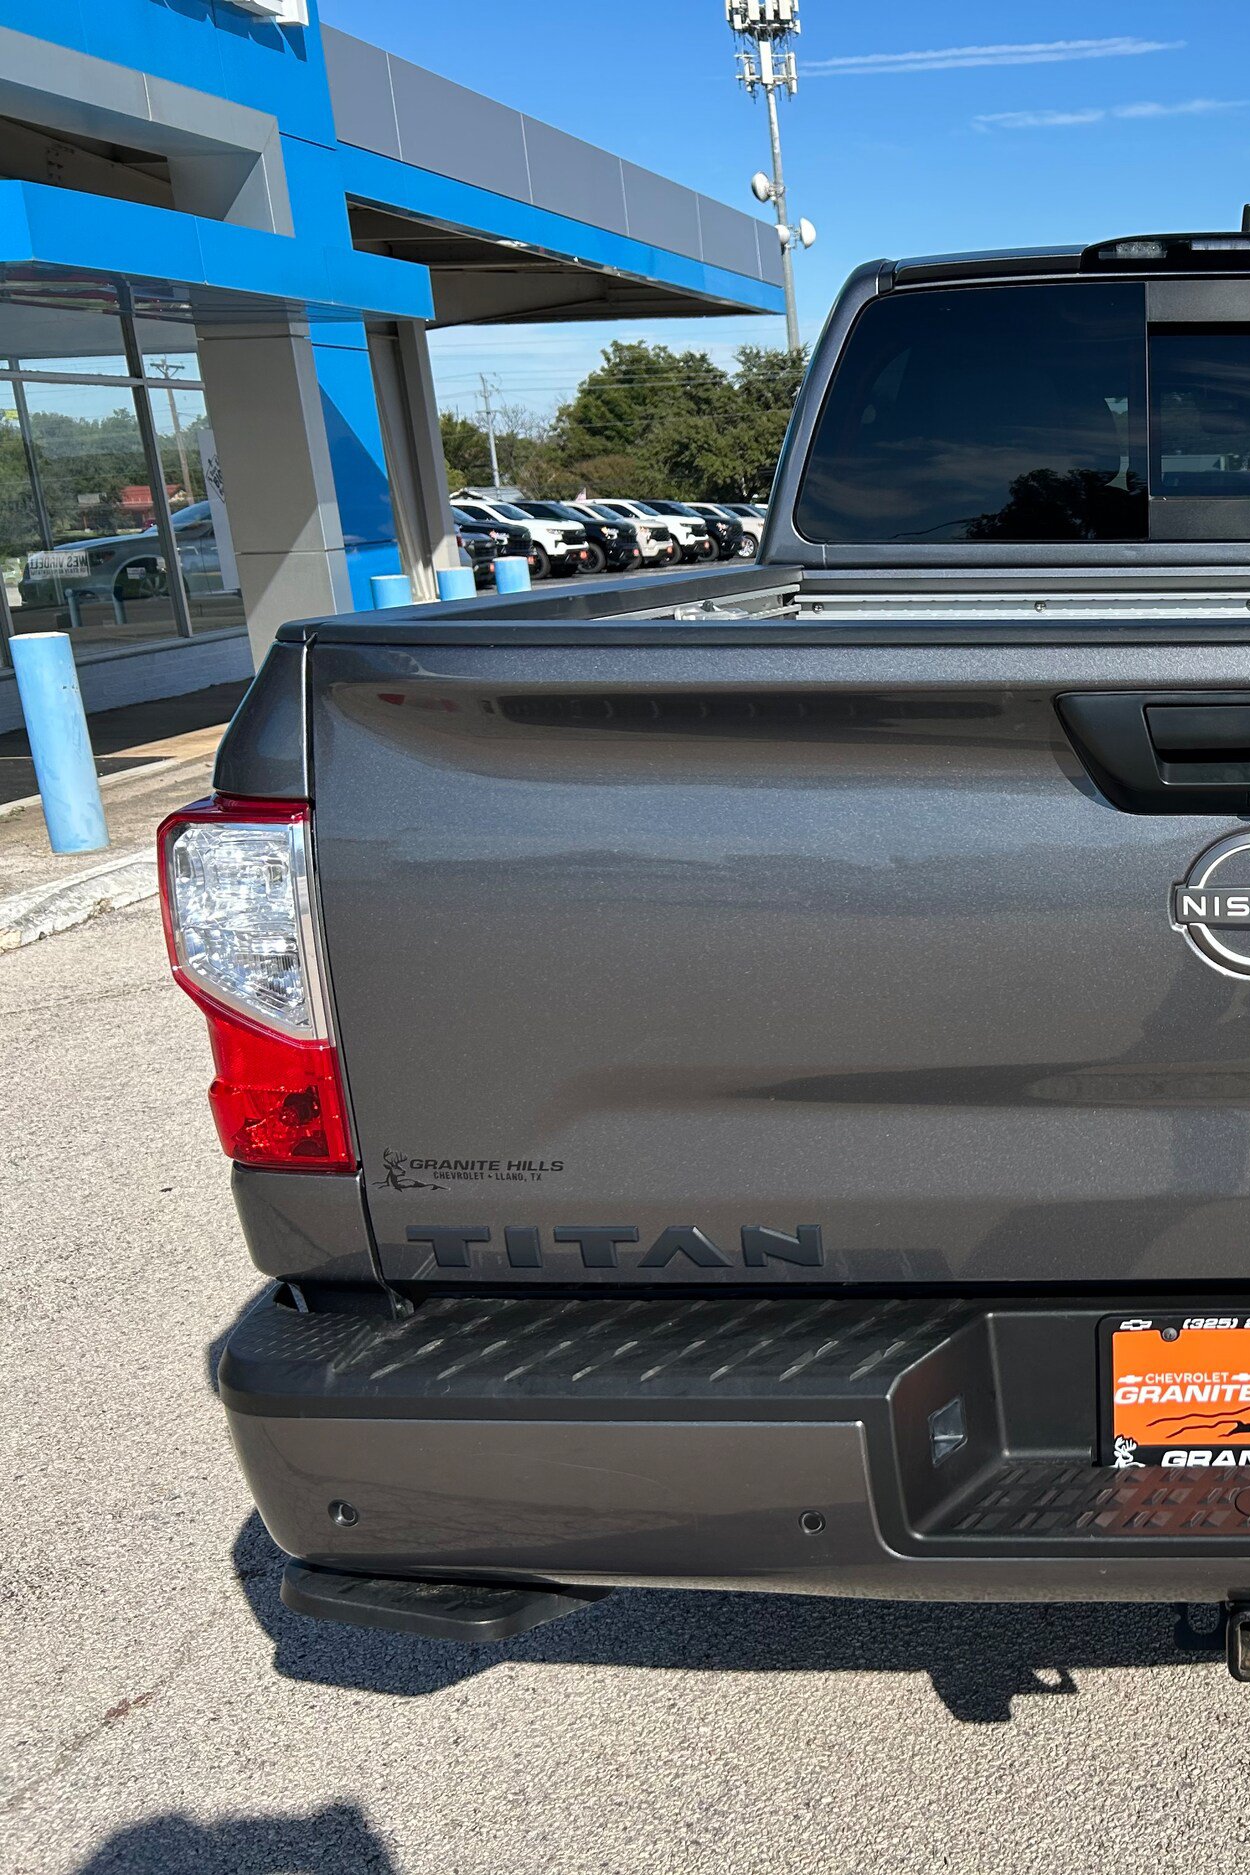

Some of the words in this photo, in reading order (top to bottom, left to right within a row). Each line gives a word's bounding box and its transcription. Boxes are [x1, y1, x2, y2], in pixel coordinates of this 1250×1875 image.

[409, 1158, 501, 1171] GRANITE
[506, 1160, 565, 1172] HILLS
[433, 1171, 485, 1180] CHEVROLET
[495, 1172, 527, 1182] LLANO,
[530, 1173, 542, 1181] TX
[406, 1225, 824, 1268] TITAN
[1182, 1317, 1239, 1330] (325)
[1145, 1372, 1229, 1384] CHEVROLET
